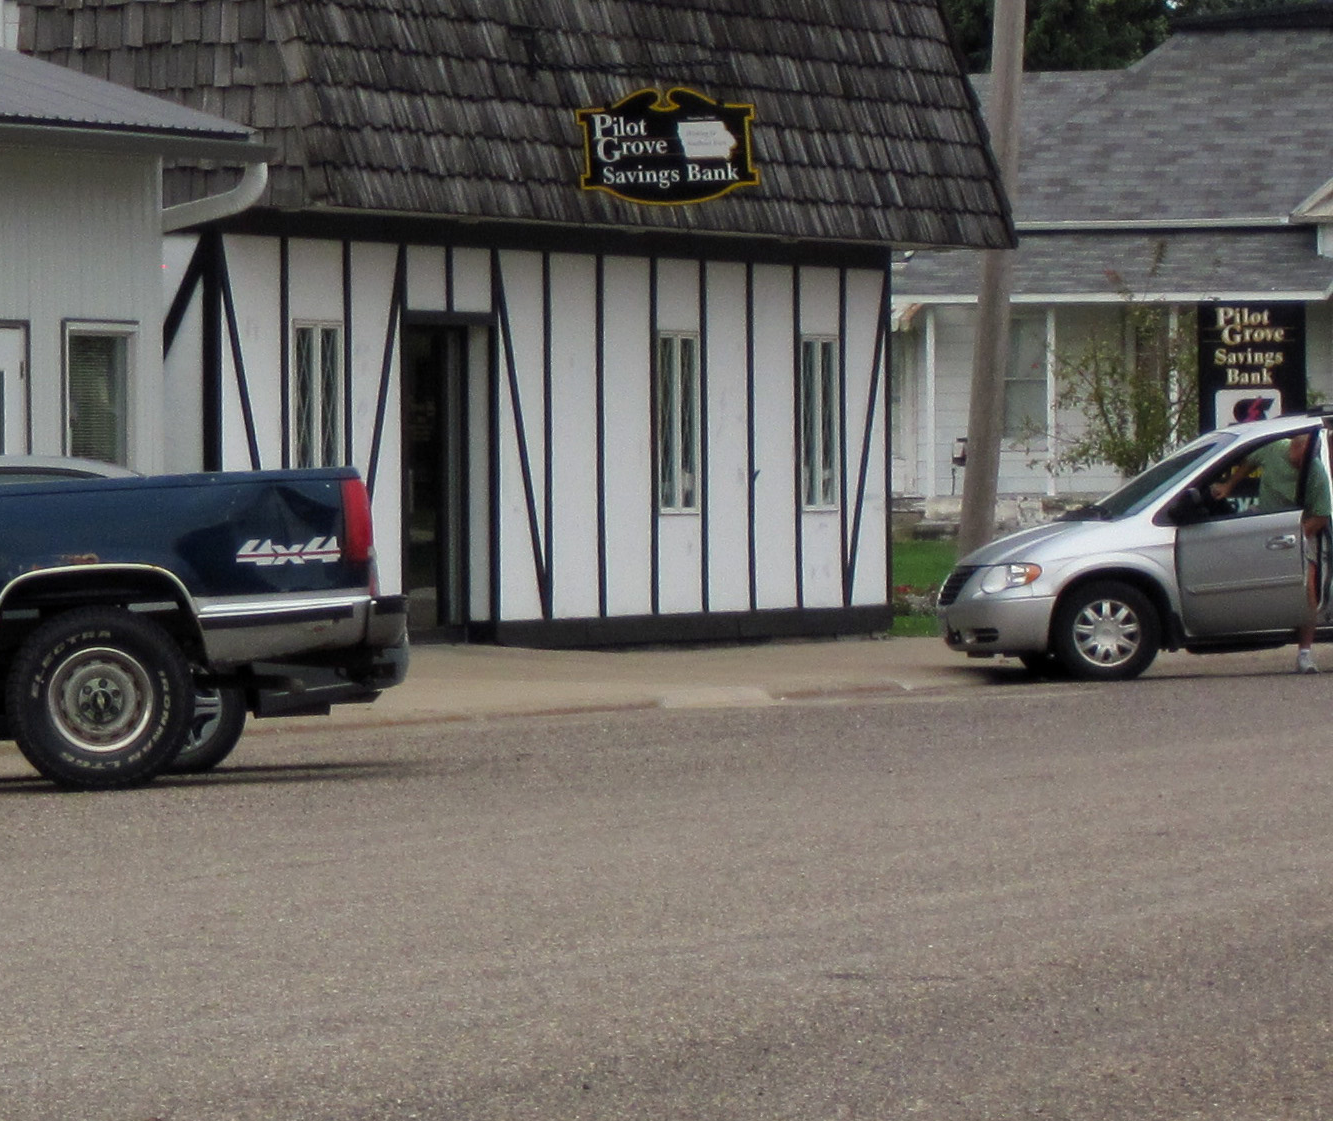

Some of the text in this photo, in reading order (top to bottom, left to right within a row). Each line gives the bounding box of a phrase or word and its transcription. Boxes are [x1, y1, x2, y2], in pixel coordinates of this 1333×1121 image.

[591, 114, 647, 140] Pilot
[596, 137, 668, 163] Grove
[603, 162, 739, 189] Savings Bank
[1215, 306, 1270, 328] Pilot
[1221, 324, 1285, 346] Grove
[1214, 347, 1284, 368] Savings
[1226, 367, 1273, 385] Bank
[235, 536, 341, 565] 4x4
